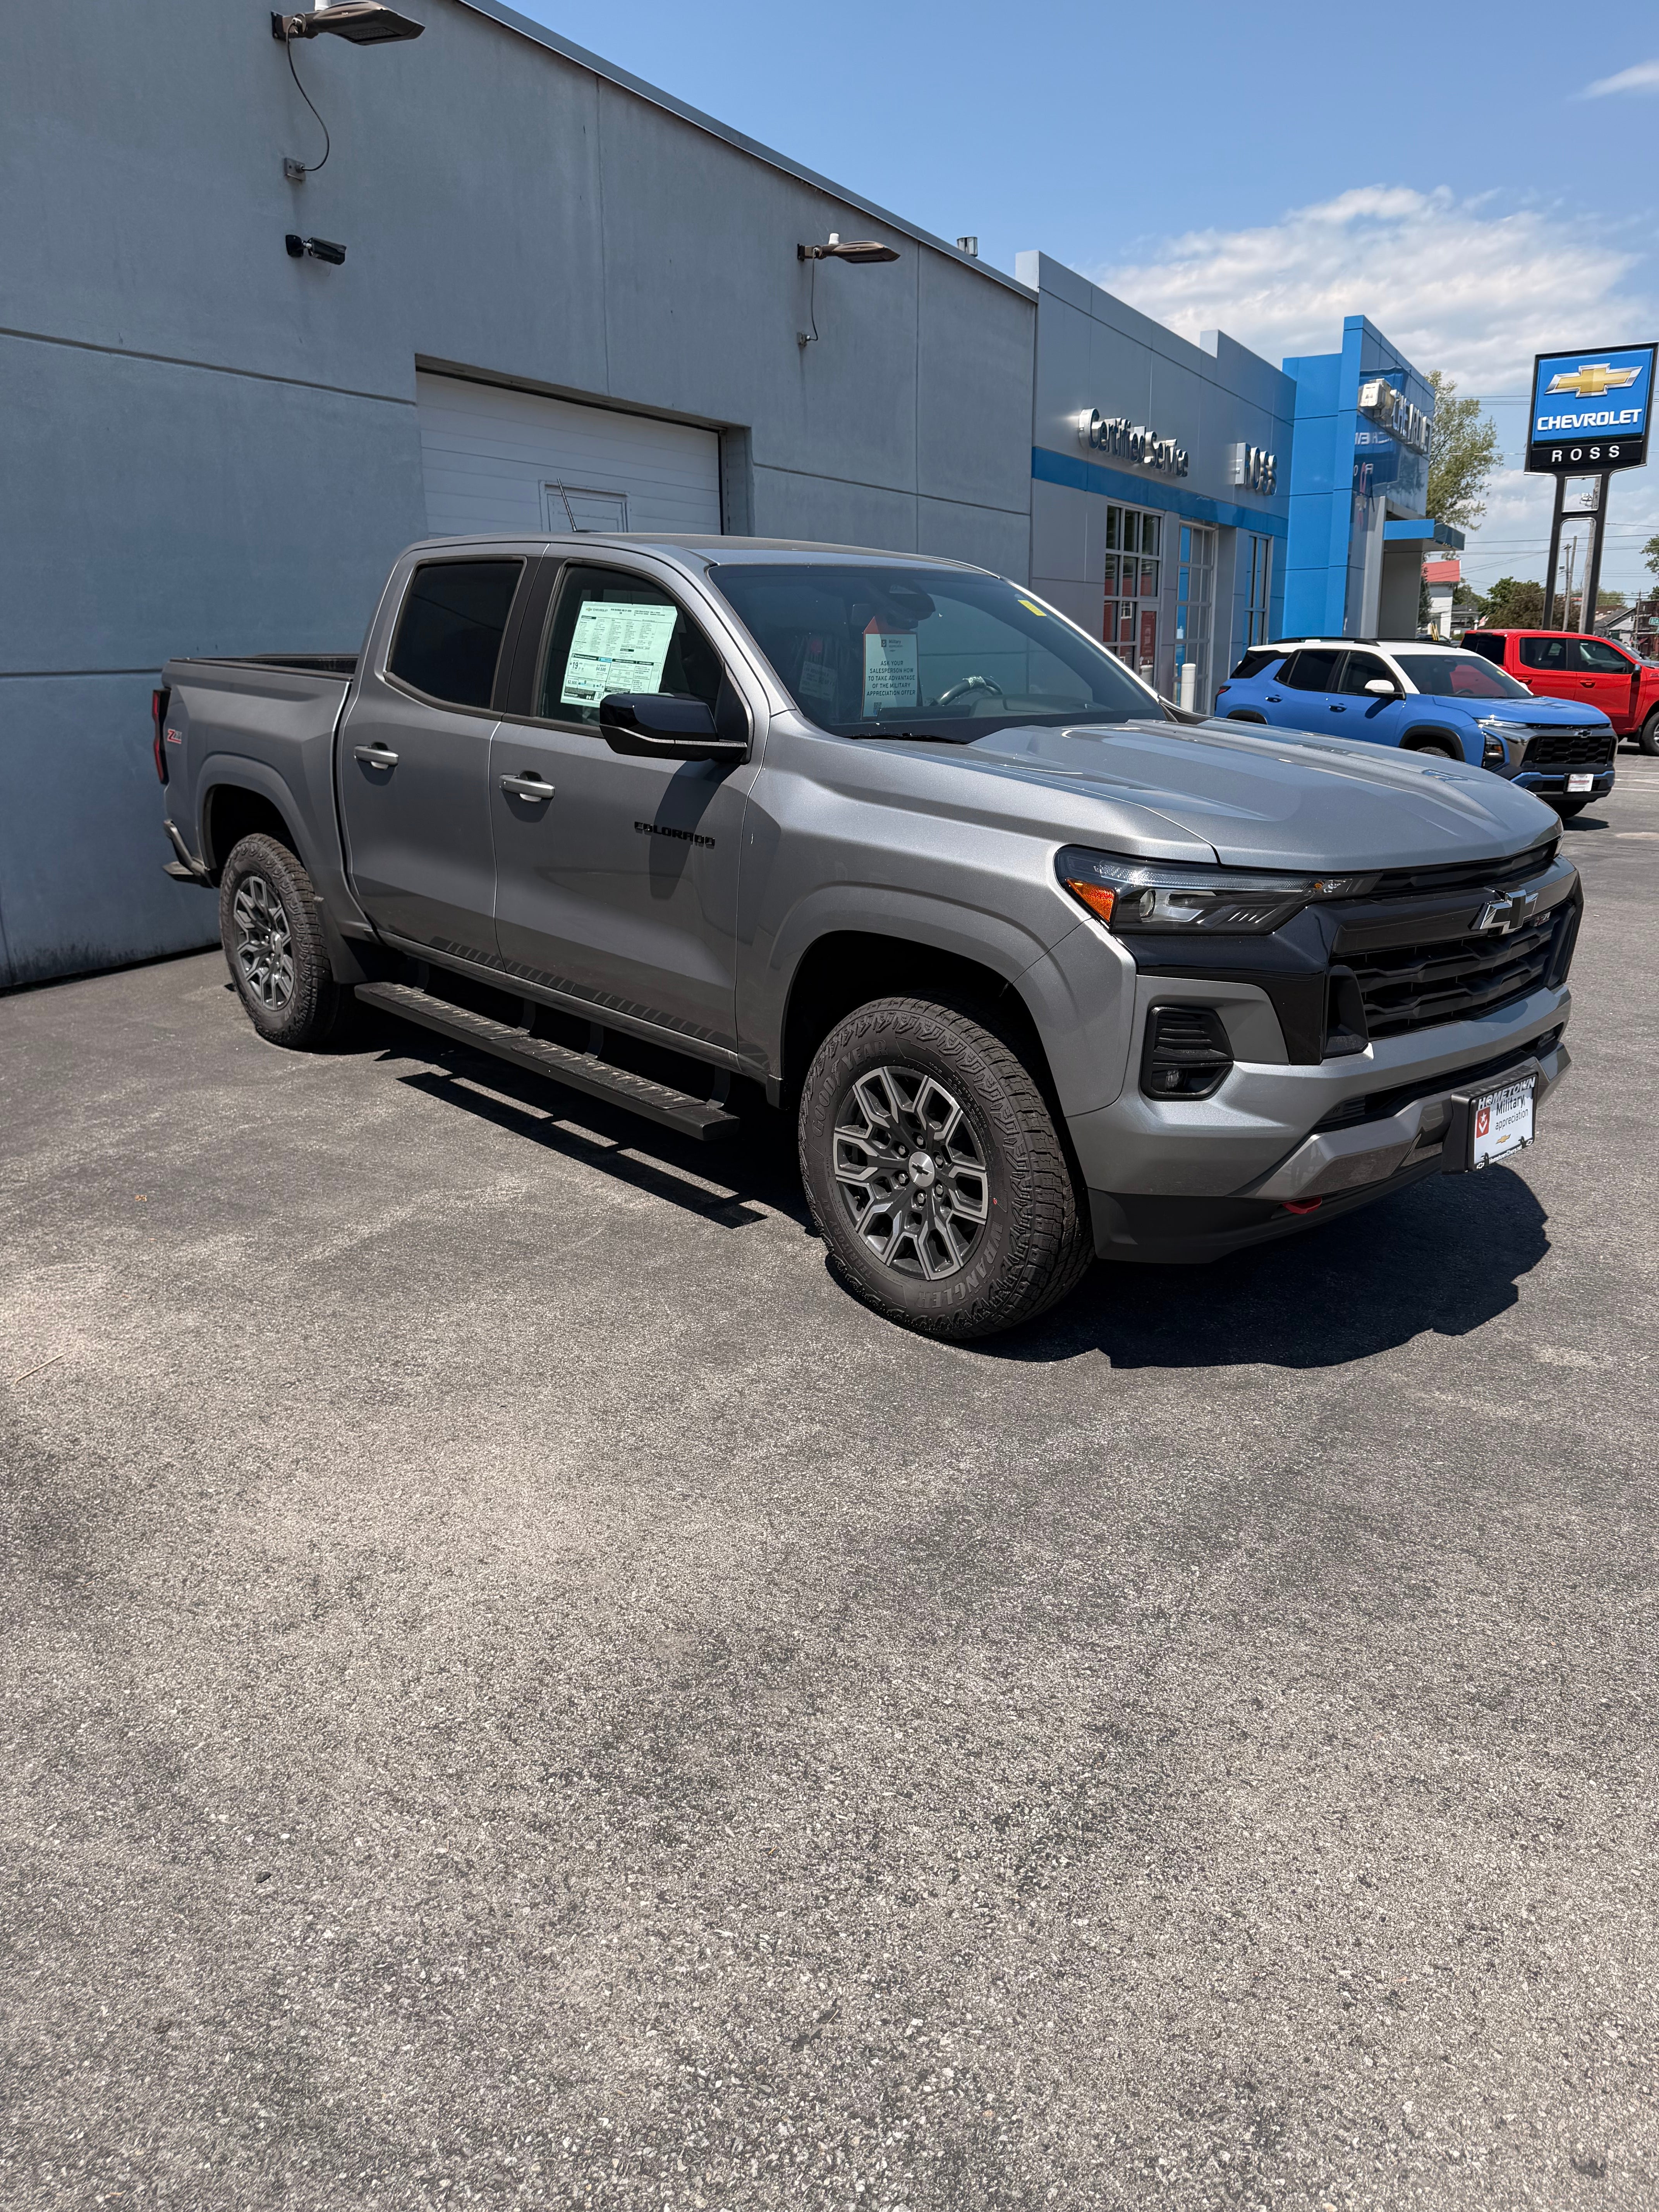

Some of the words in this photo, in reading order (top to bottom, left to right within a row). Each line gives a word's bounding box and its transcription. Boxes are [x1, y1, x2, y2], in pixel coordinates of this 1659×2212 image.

[1537, 409, 1642, 431] CHEVROLET
[1079, 408, 1146, 463] Certified
[1144, 431, 1189, 477] Service
[1551, 445, 1620, 463] ROSS
[1235, 442, 1278, 496] ROSS
[634, 821, 715, 847] COLORADO
[1478, 1077, 1536, 1109] HOMETOWN
[1496, 1094, 1525, 1116] Military
[1495, 1108, 1529, 1131] appreciation
[830, 1220, 873, 1278] TERRITORY
[917, 1221, 1003, 1309] WRANGLER
